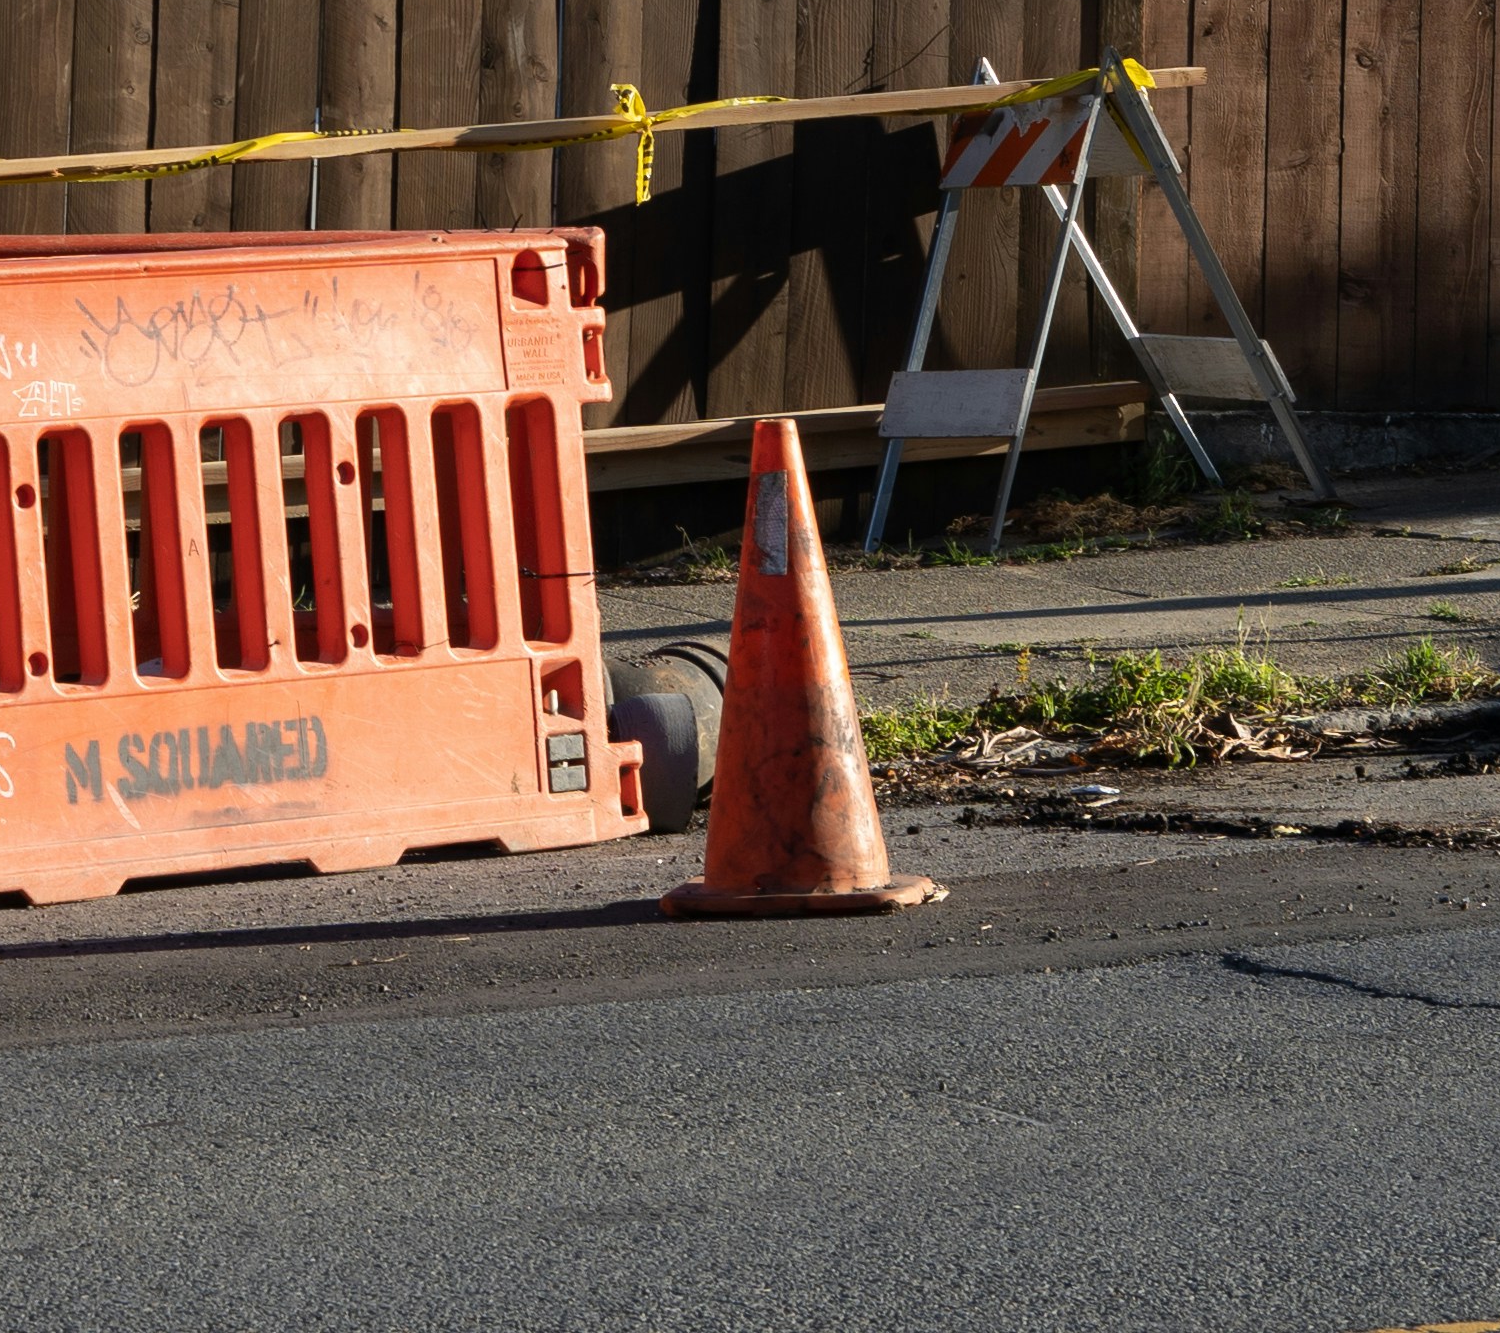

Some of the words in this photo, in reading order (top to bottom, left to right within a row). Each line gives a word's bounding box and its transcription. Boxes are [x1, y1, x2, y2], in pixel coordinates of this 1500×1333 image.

[506, 335, 557, 348] URBANITE
[522, 347, 549, 359] WALL
[515, 372, 535, 382] MADE
[547, 371, 562, 380] USA
[188, 538, 200, 556] A
[65, 739, 100, 805] M
[117, 715, 328, 801] SQUARED
